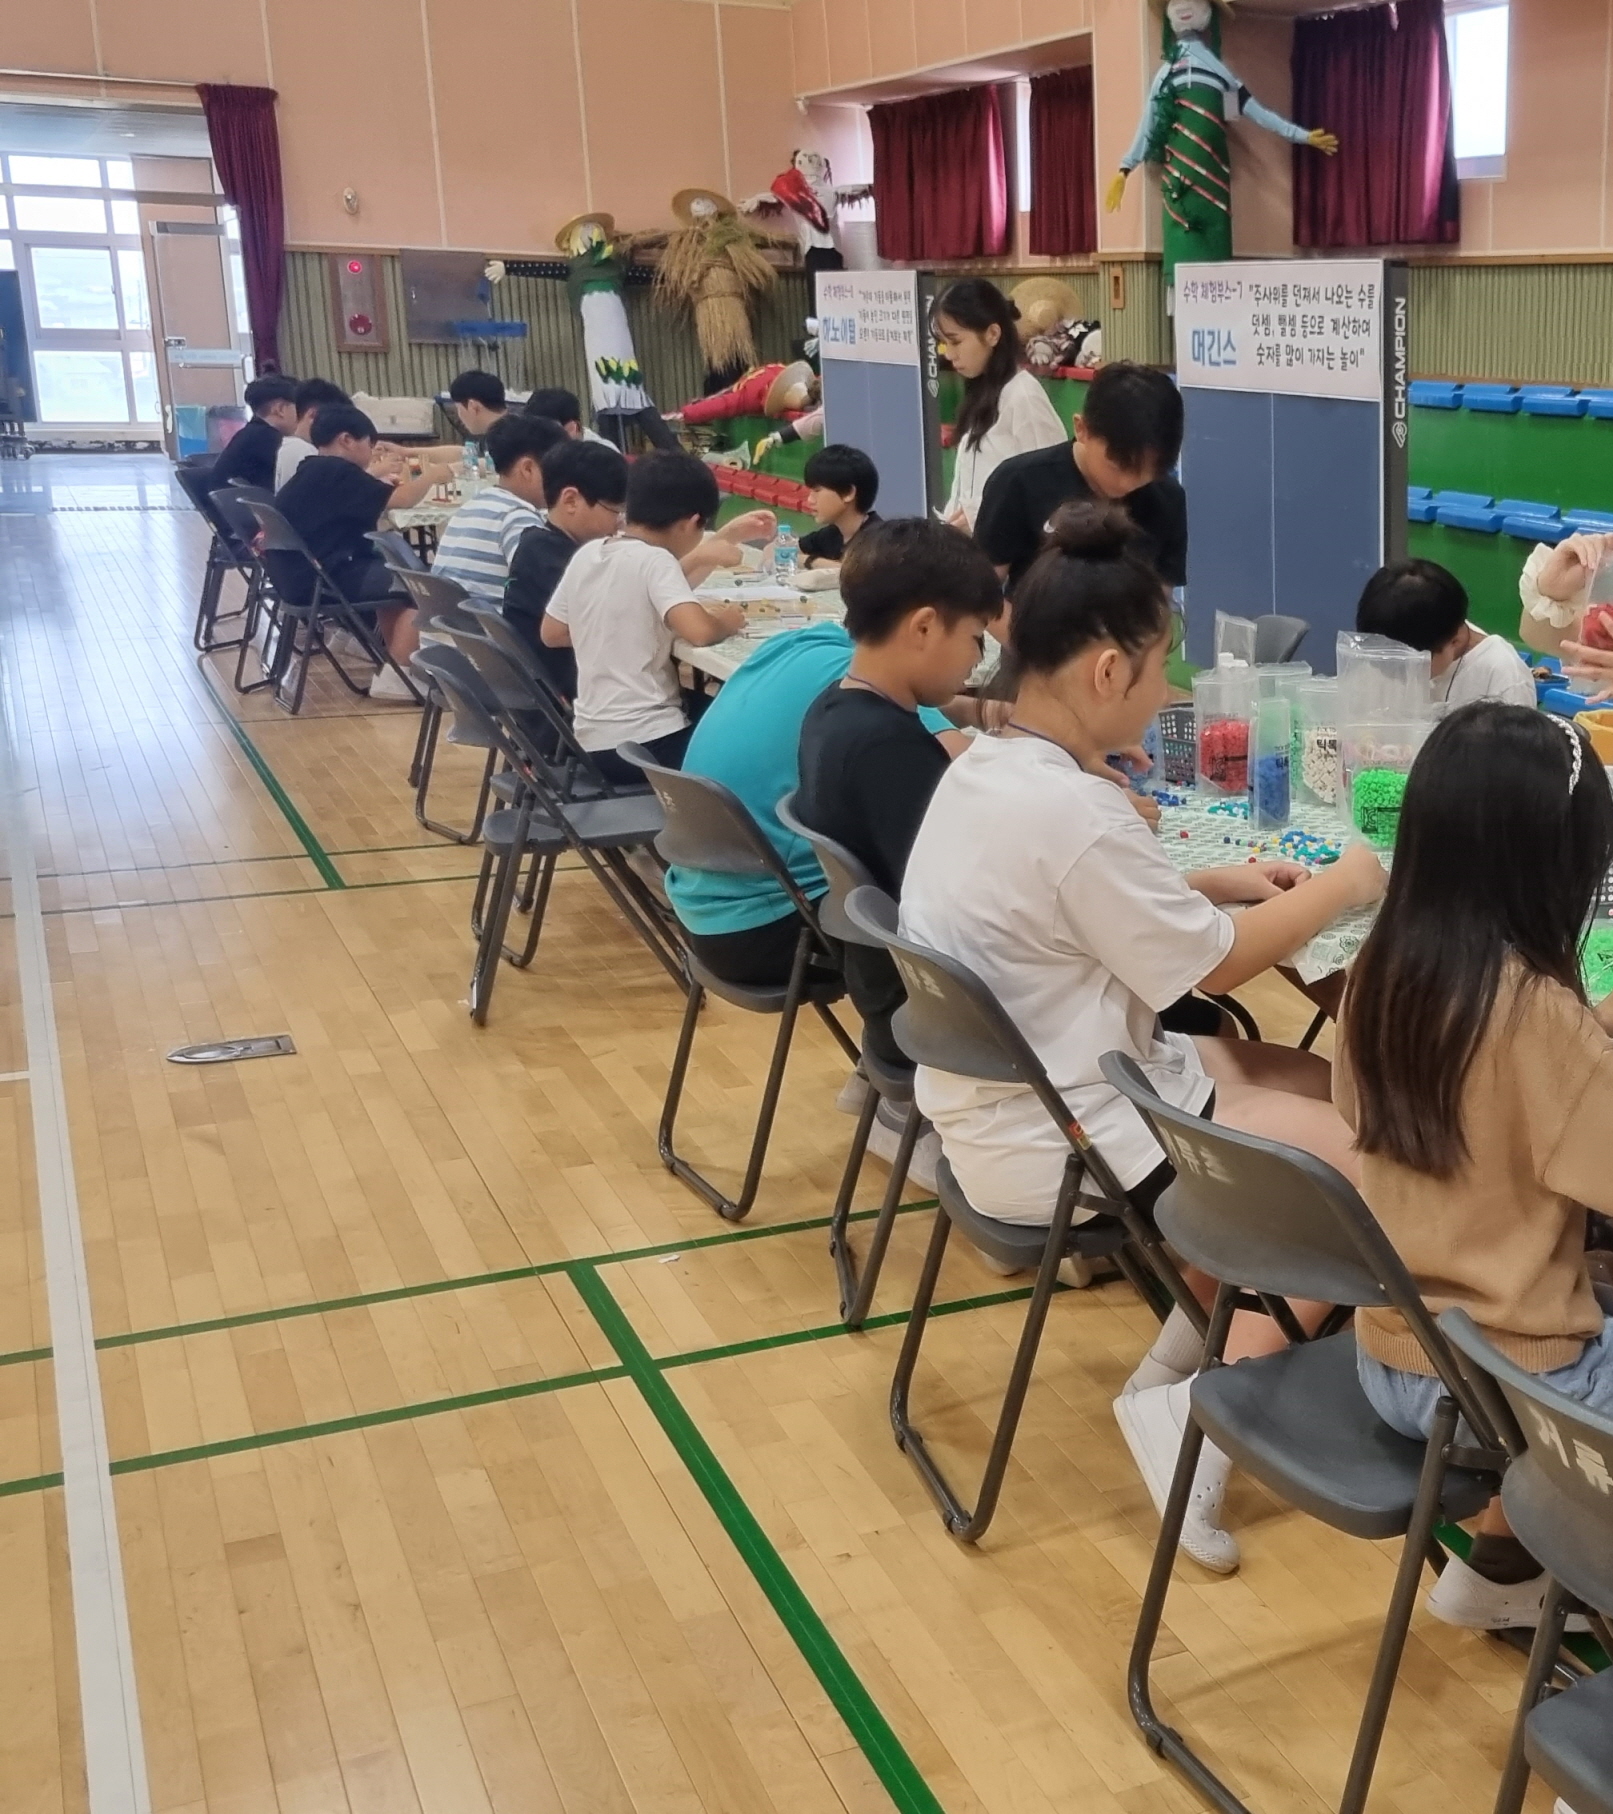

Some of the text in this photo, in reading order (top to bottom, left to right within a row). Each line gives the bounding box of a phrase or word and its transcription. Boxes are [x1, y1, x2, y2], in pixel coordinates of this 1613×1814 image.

[1183, 280, 1242, 304] 수학 체험부스-7
[1249, 284, 1375, 310] "주사위를 던져서 나오는 수를
[1278, 314, 1297, 338] 뺄셈
[1301, 314, 1324, 339] 등으로
[1330, 315, 1371, 340] 계산하여
[1192, 328, 1237, 367] 머긴스
[1256, 343, 1365, 372] 숫자를 많이 가지는 놀이"
[1394, 297, 1406, 419] CHAMPION
